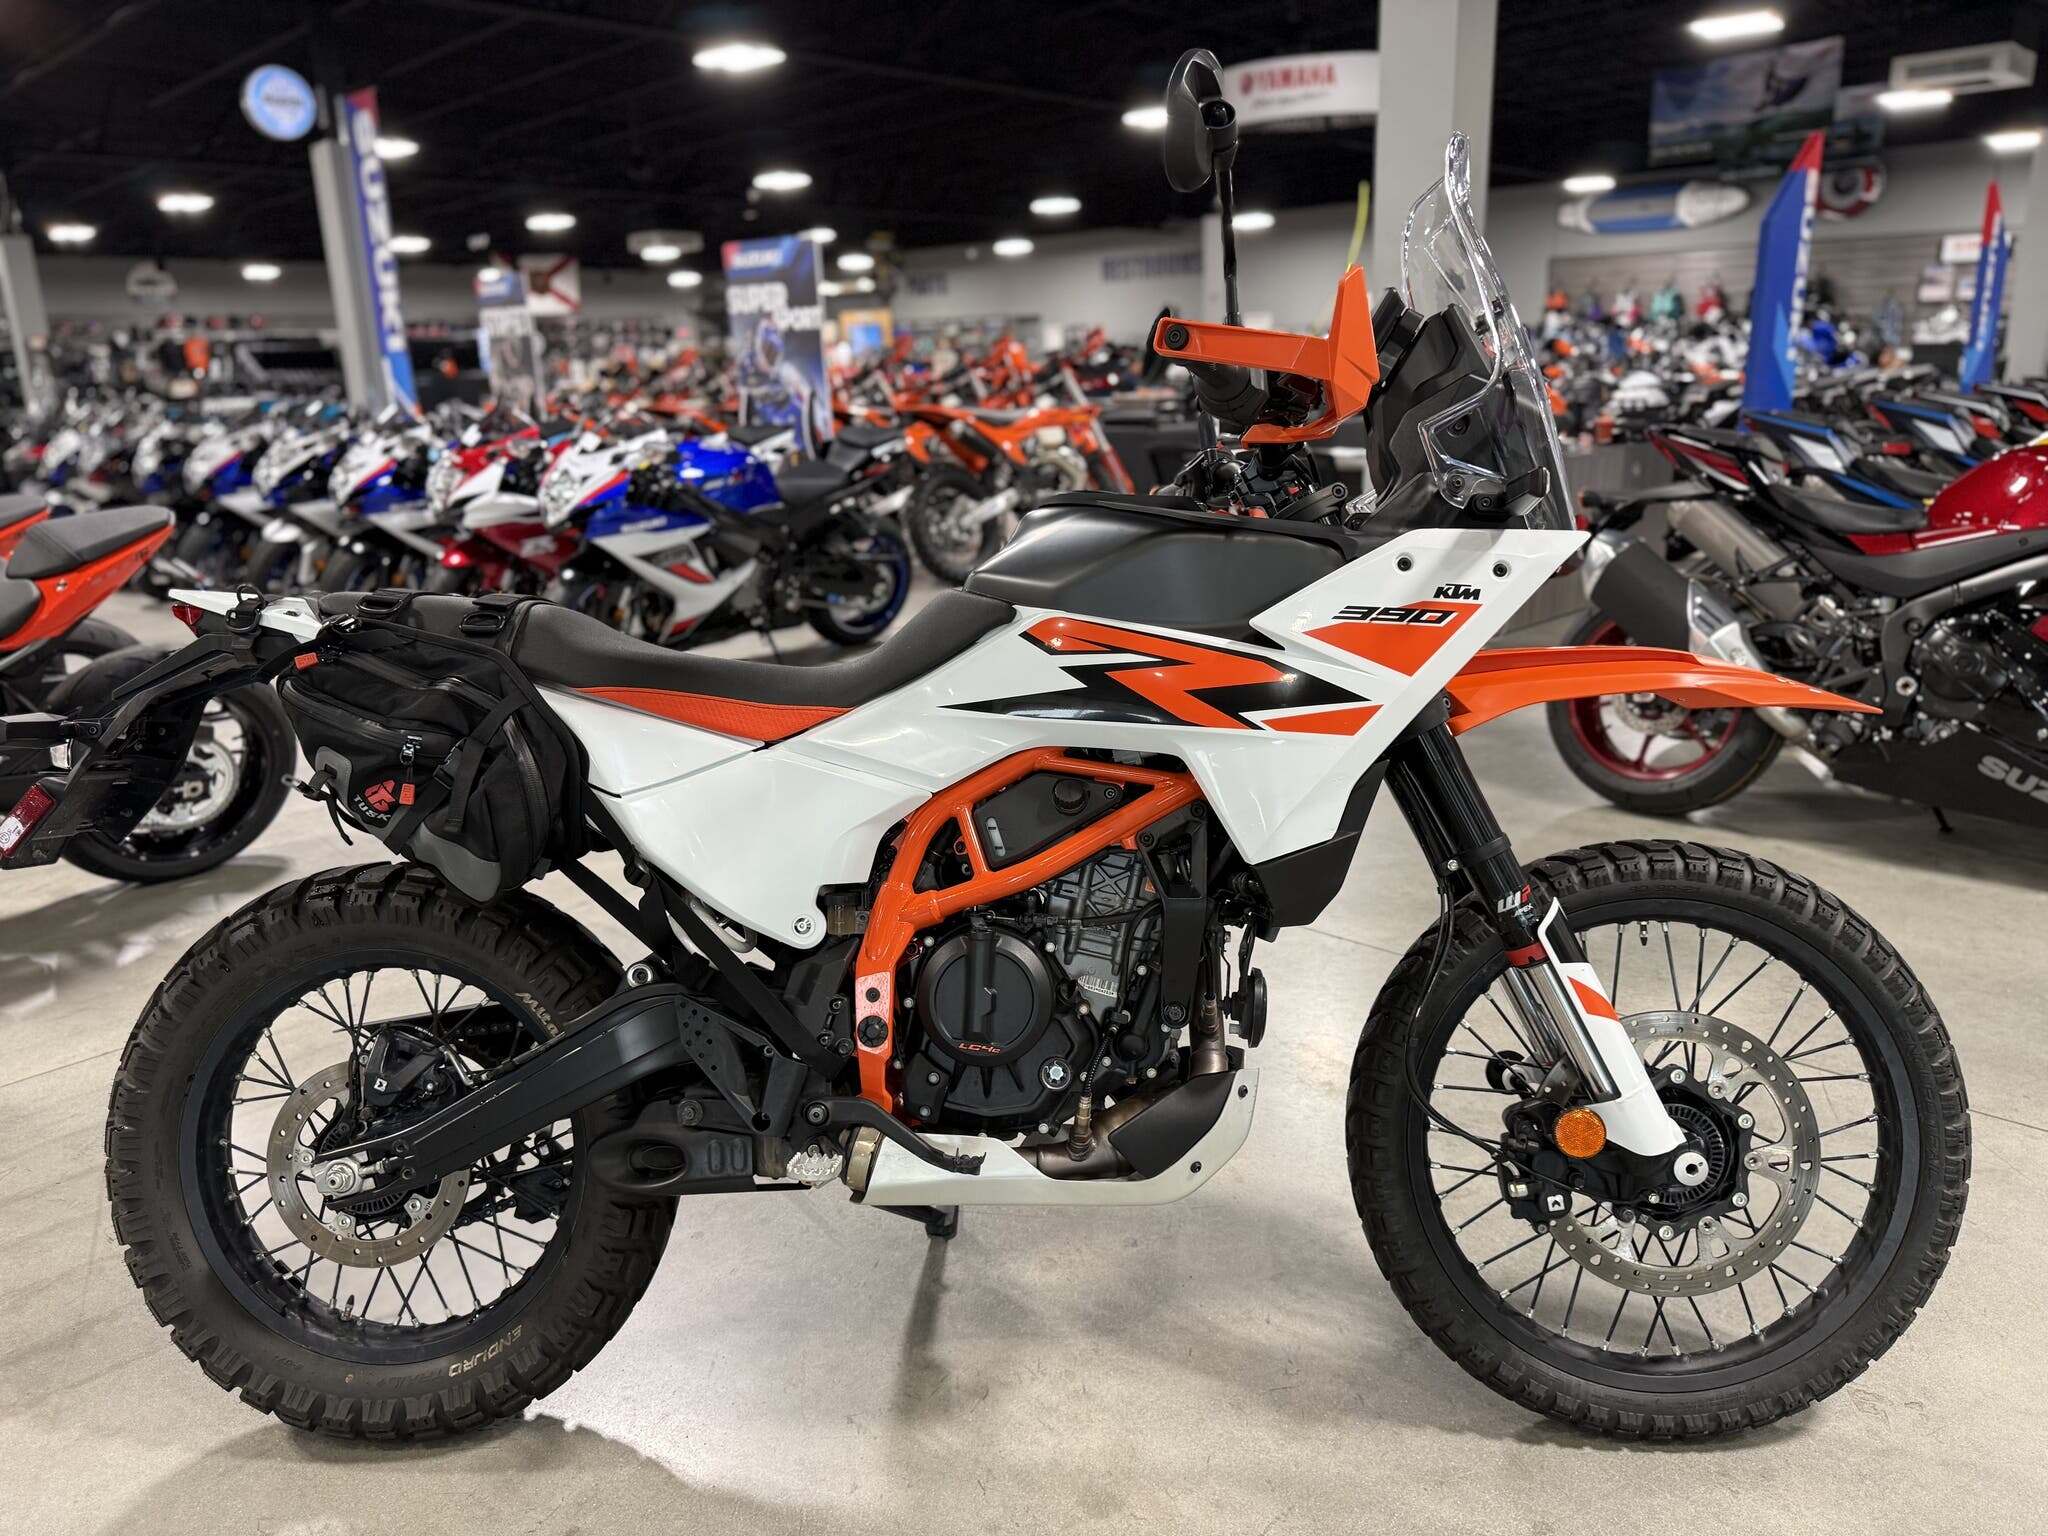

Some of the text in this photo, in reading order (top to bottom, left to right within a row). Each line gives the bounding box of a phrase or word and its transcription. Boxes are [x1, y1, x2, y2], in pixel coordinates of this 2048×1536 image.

[352, 108, 406, 353] SUZUKI
[726, 282, 788, 315] SUPER
[1433, 583, 1481, 600] KTM
[1332, 605, 1457, 625] 390
[354, 794, 392, 822] TUSK
[448, 1324, 523, 1378] ENDURO
